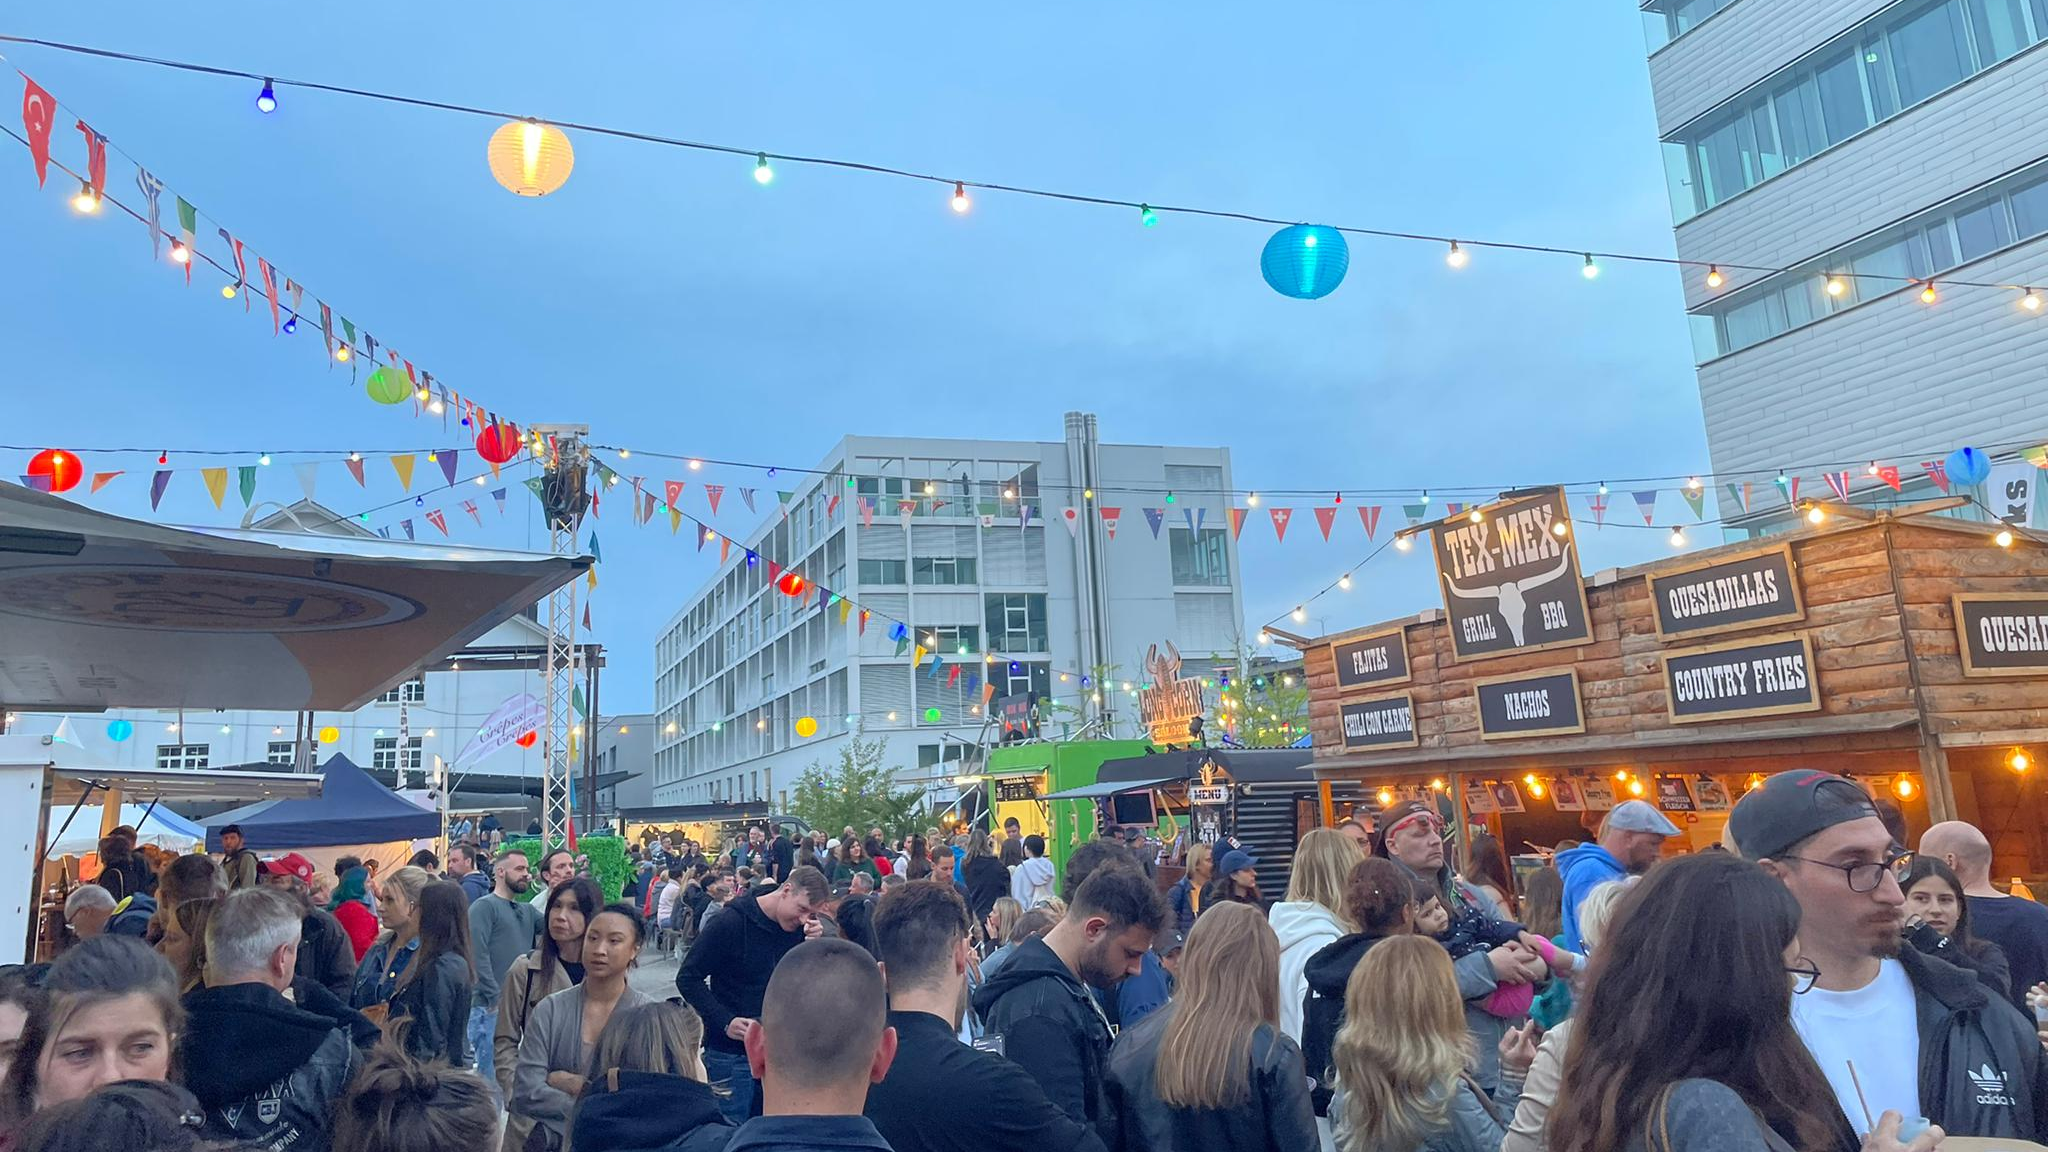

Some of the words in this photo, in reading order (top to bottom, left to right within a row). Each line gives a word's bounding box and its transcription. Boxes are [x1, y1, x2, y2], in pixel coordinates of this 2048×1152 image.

[1444, 503, 1561, 580] TEX-MEX
[1668, 568, 1780, 619] QUESADILLAS
[1462, 613, 1497, 643] GRILL
[1540, 600, 1569, 631] BBQ
[1352, 646, 1389, 675] FAJITAS
[1674, 662, 1748, 702] COUNTRY
[1752, 654, 1807, 694] FRIES
[1344, 712, 1365, 738] CHILI
[1365, 711, 1382, 736] CON
[1382, 707, 1412, 734] CARNE
[1504, 689, 1550, 721] NACHOS
[1194, 789, 1221, 800] MENU
